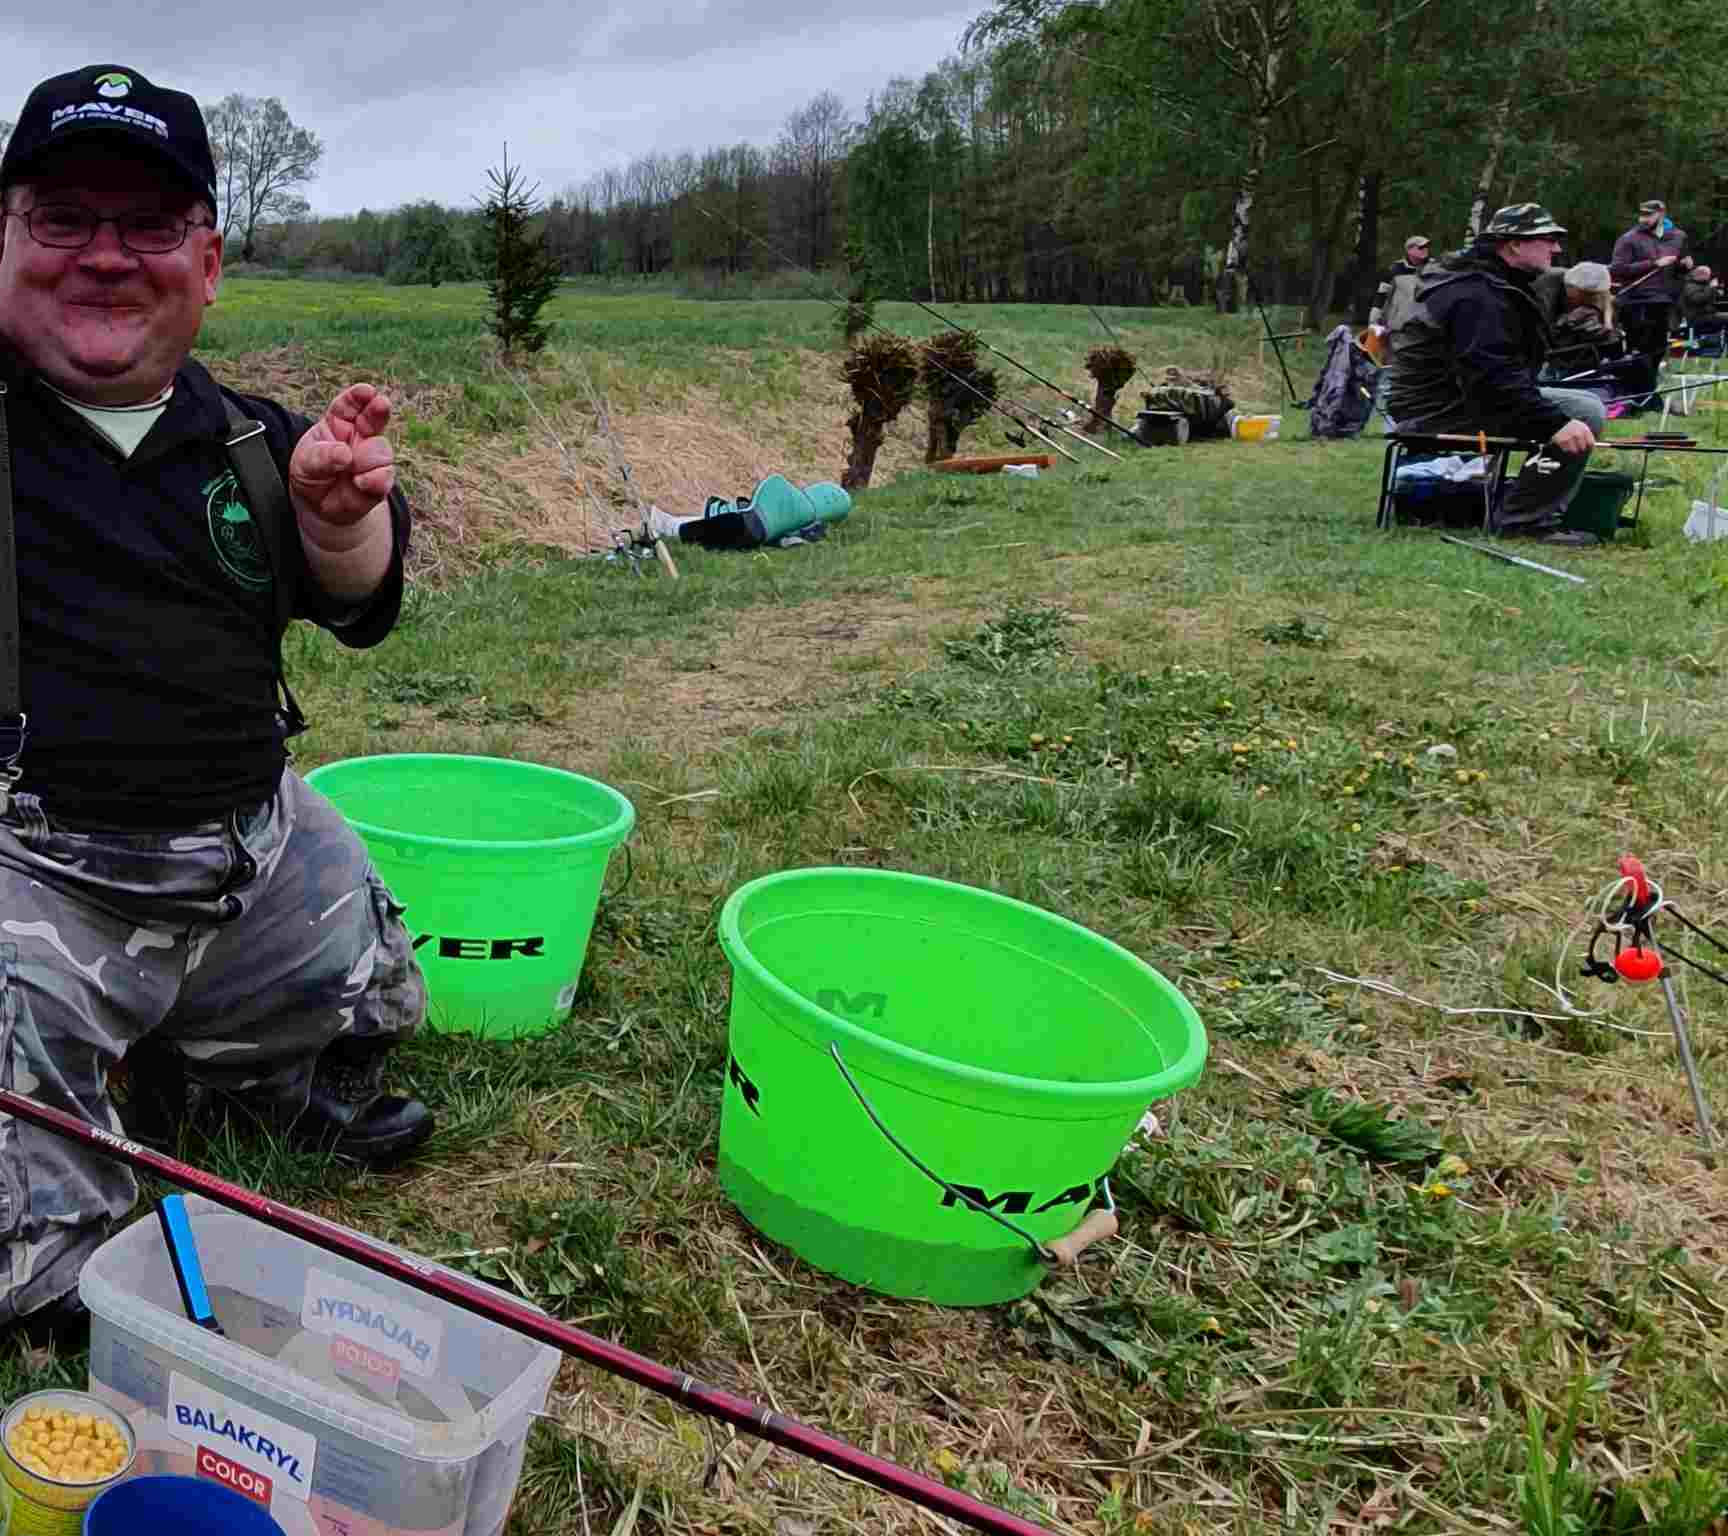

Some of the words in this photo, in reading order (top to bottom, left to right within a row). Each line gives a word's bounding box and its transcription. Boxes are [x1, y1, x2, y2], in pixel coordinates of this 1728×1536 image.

[52, 102, 168, 129] MAVER
[175, 1404, 303, 1484] BALAKRYL
[202, 1455, 265, 1498] COLOR
